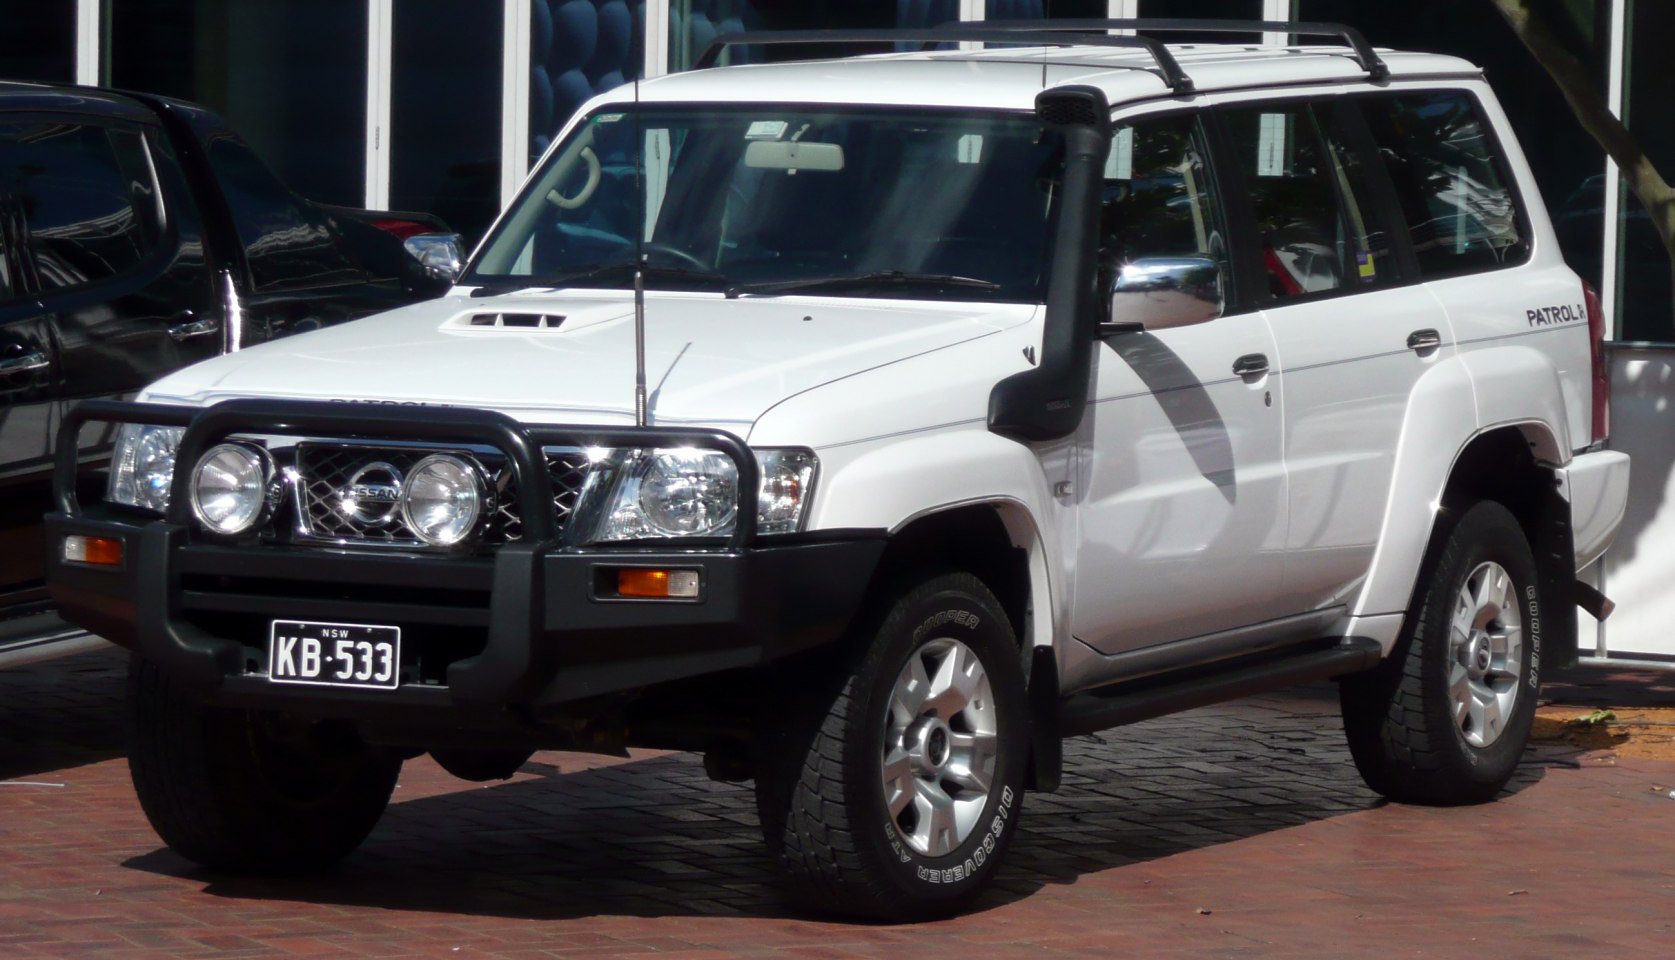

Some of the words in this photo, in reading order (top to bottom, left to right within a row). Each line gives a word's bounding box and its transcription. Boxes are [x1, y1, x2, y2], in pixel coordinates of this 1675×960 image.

[1526, 304, 1579, 327] PATROL
[322, 628, 349, 639] NSW
[917, 784, 1014, 884] DISCOVERER
